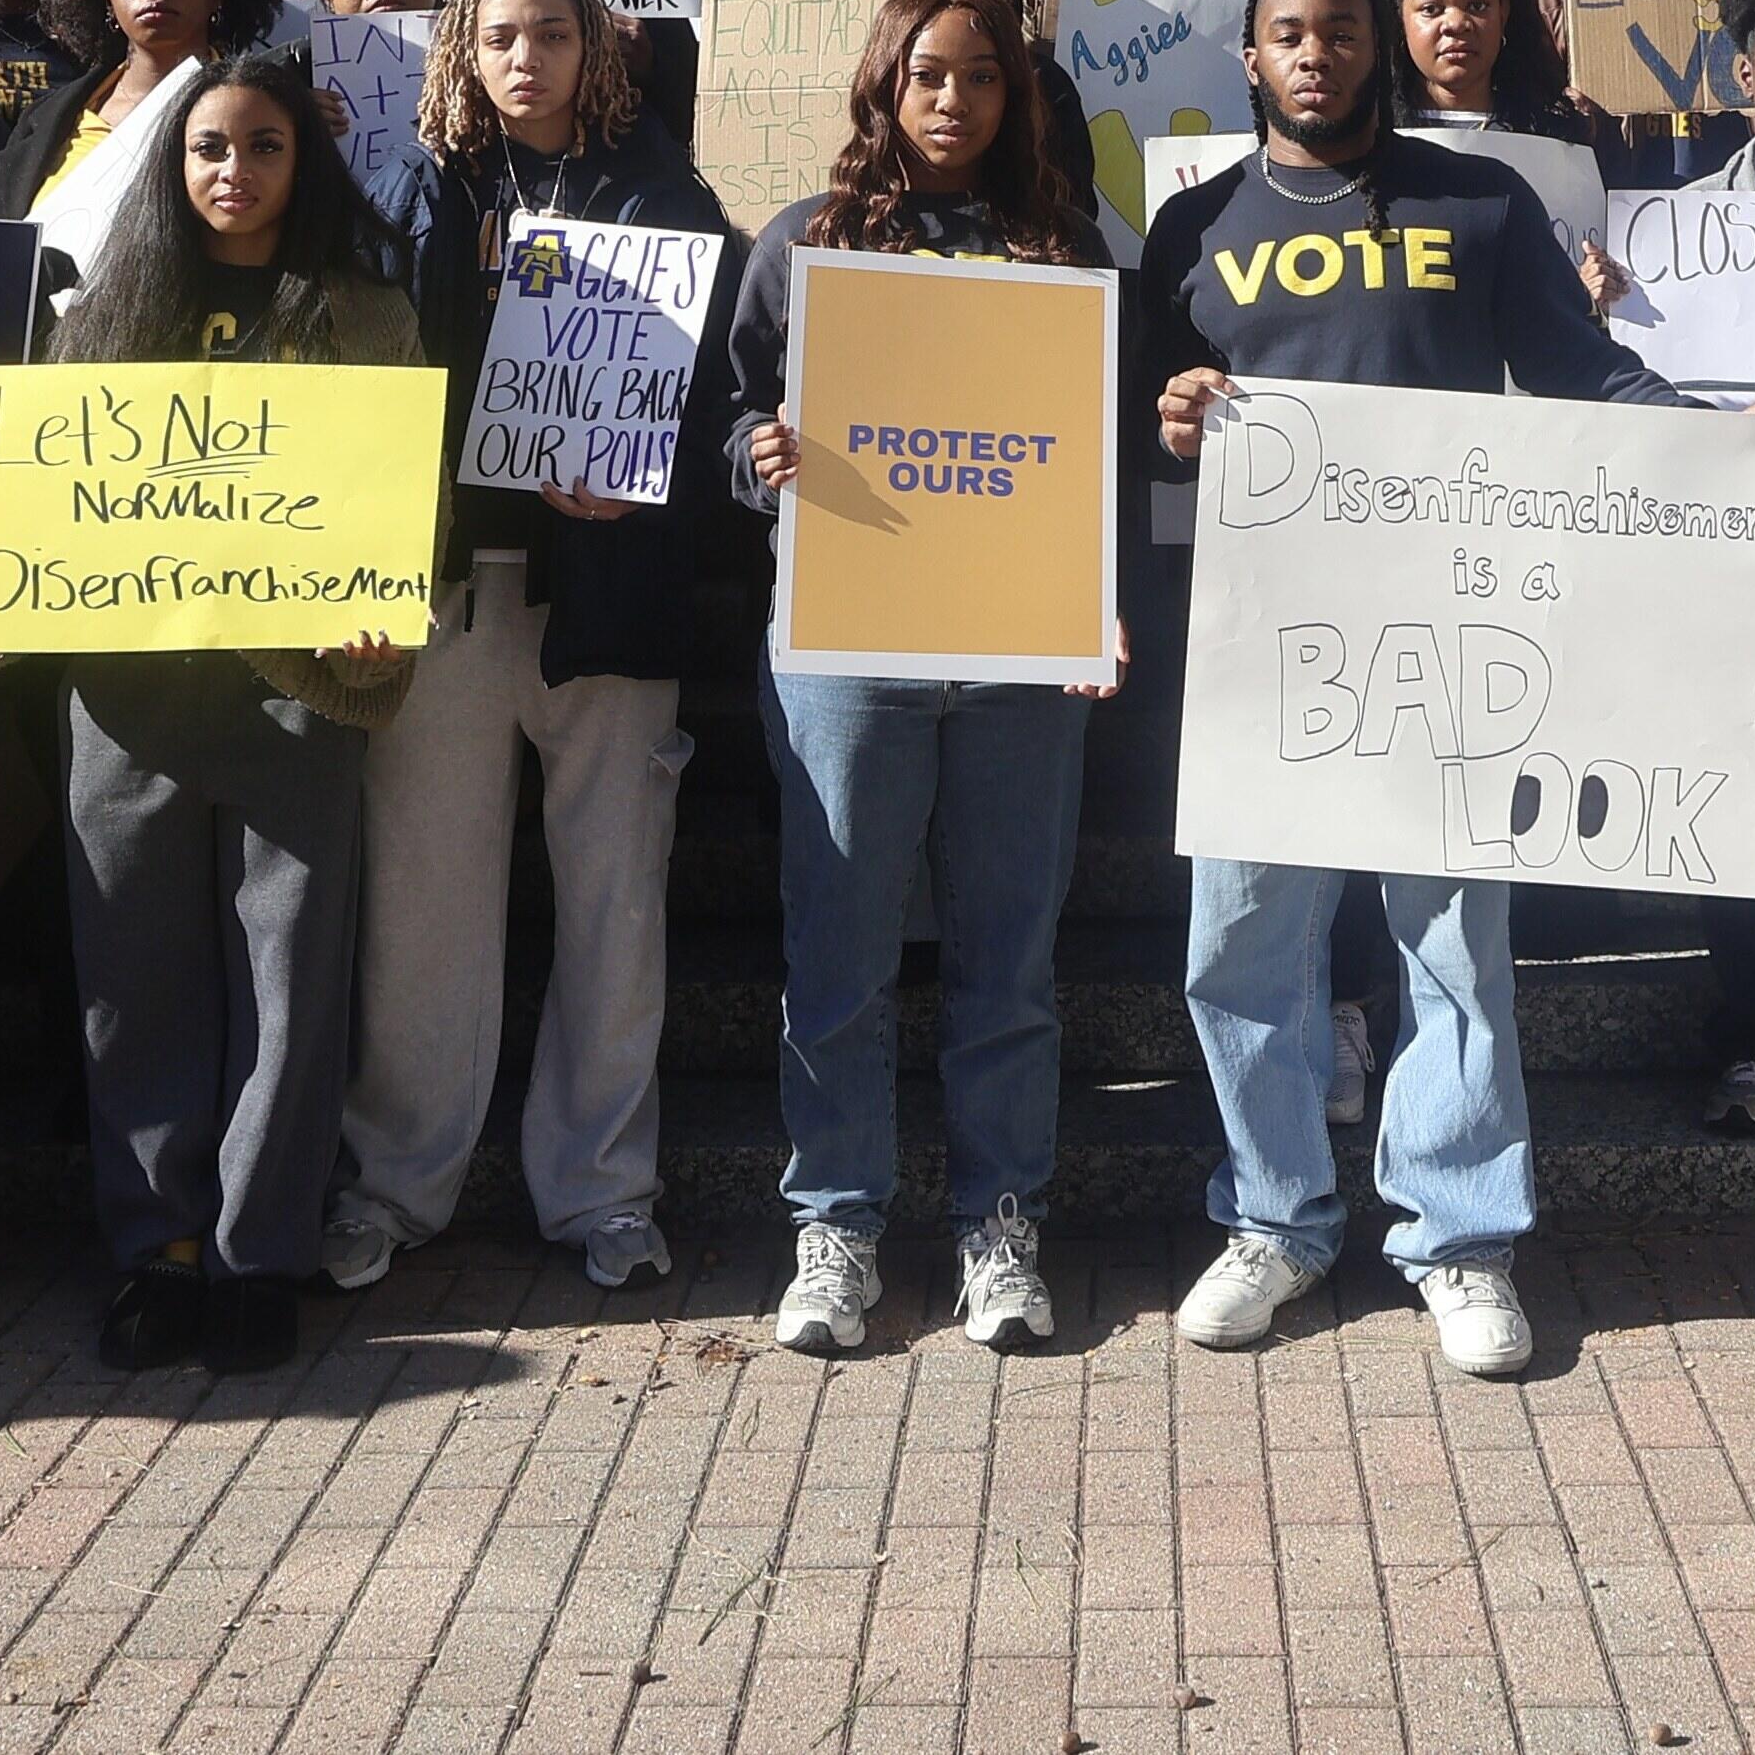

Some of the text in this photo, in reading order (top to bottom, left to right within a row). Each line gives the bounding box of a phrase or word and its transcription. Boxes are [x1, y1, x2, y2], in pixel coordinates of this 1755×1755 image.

[1071, 11, 1192, 86] Aggies
[748, 121, 818, 166] IS
[1214, 226, 1456, 306] VOTE
[542, 305, 663, 362] VOTE
[481, 358, 689, 424] BRING BACK
[161, 392, 290, 468] Not
[476, 423, 676, 497] OUR POLLS
[847, 424, 1057, 464] PROTECT
[887, 463, 1015, 497] OURS
[1453, 548, 1560, 601] is a
[1278, 623, 1552, 762] BAD
[1442, 751, 1730, 884] LOOK
